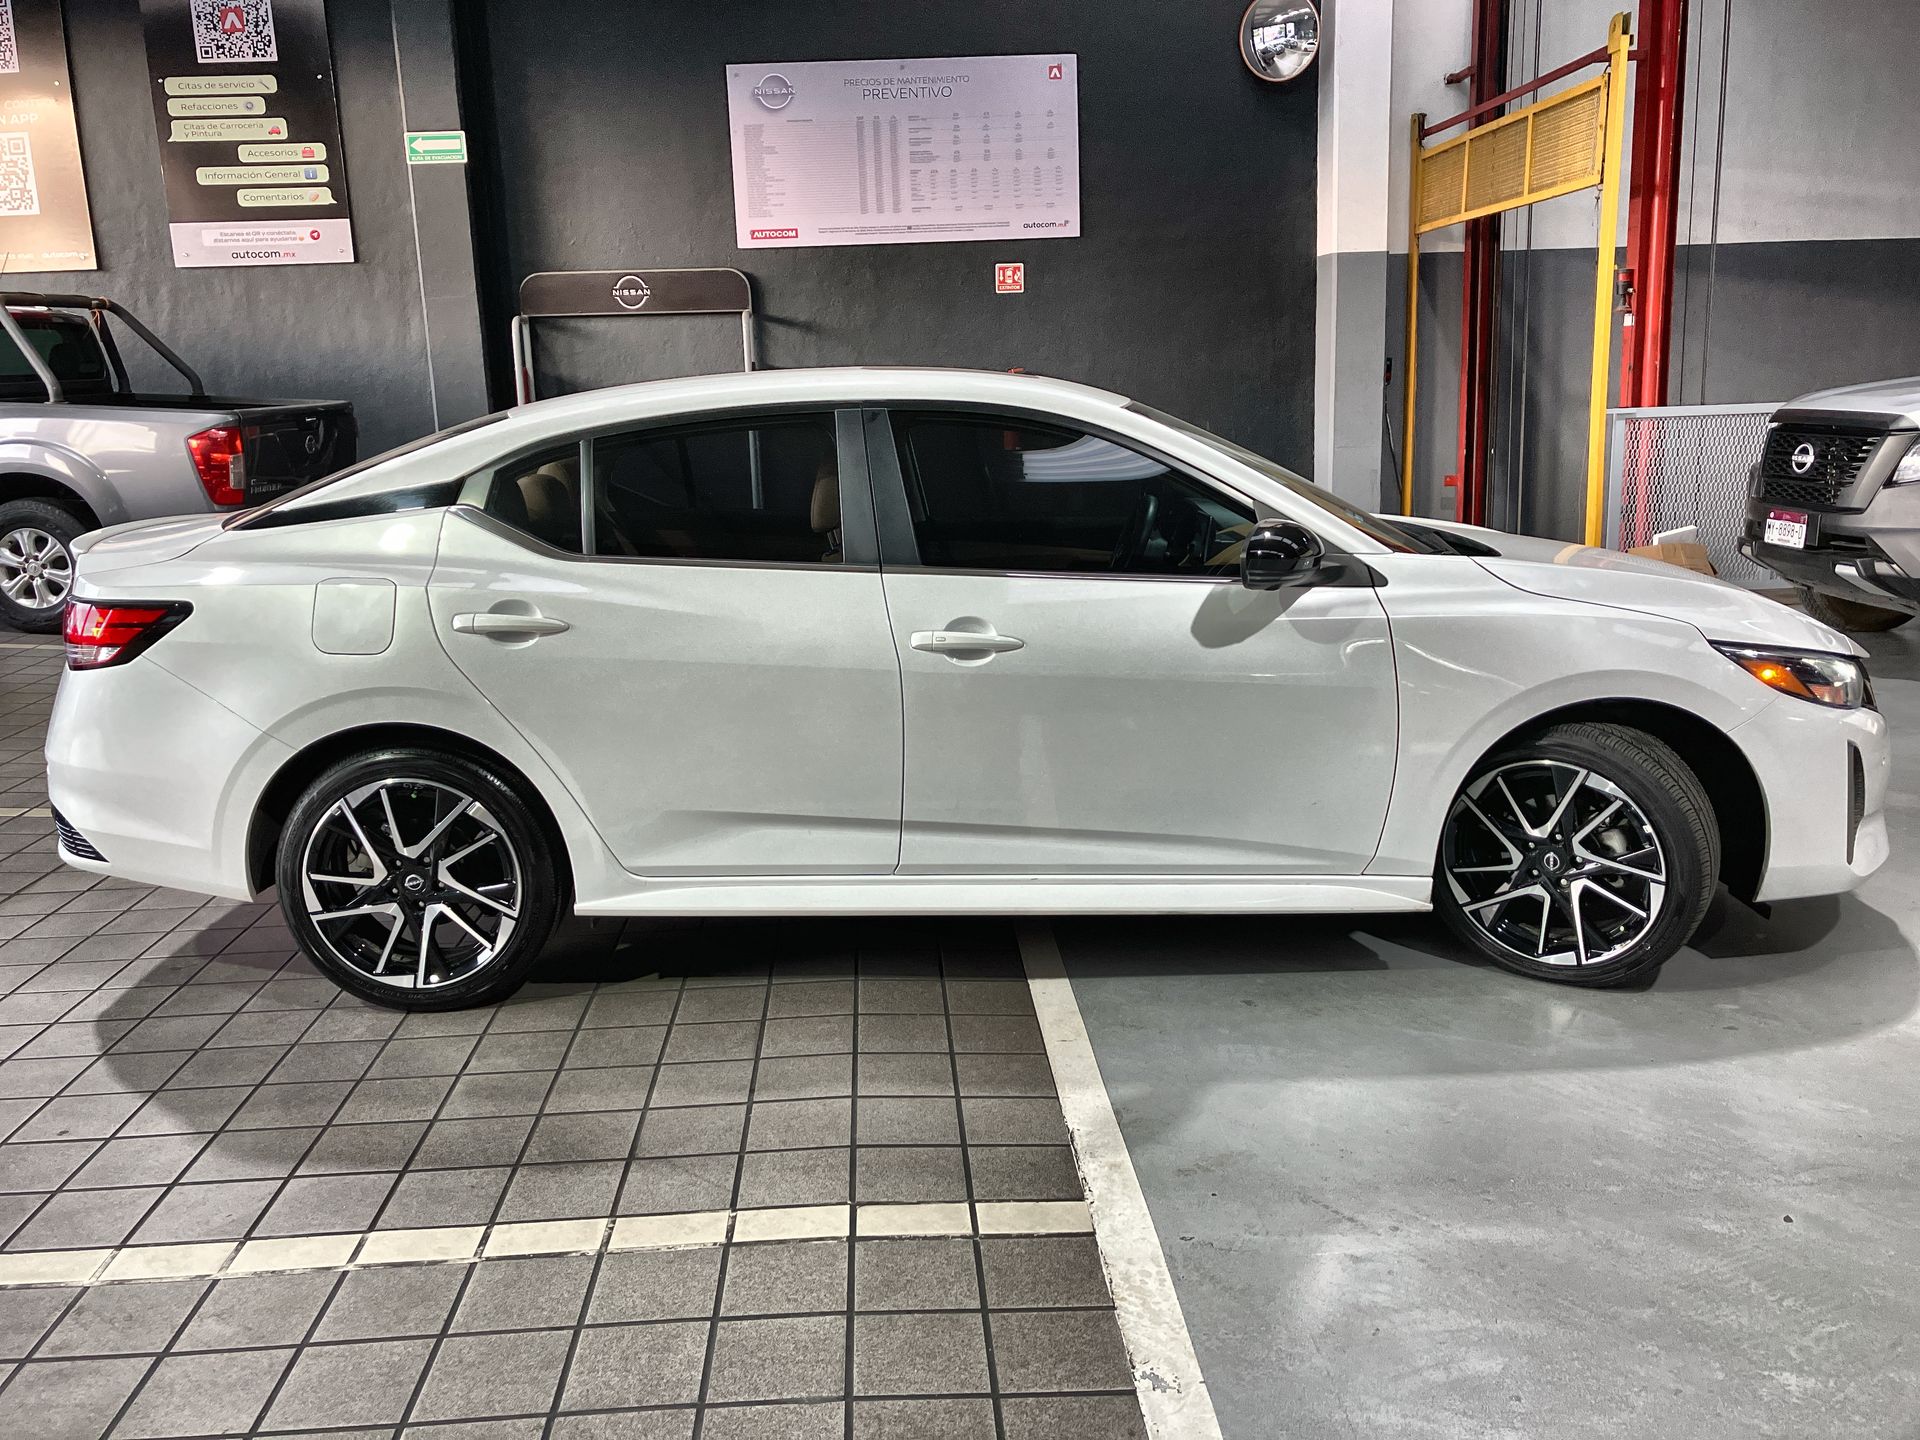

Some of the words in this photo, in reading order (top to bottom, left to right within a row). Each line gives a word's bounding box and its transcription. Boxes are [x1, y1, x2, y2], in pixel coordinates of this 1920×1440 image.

[843, 78, 881, 87] PRECIOS
[883, 77, 896, 86] DE
[897, 75, 970, 85] MANTENIMIENTO
[178, 82, 202, 90] Citas
[218, 81, 255, 89] servicio
[754, 87, 796, 96] NISSAN
[862, 86, 953, 101] PREVENTIVO
[181, 103, 239, 111] Refacciones
[184, 123, 206, 131] Citas
[191, 130, 223, 138] Pintura
[247, 149, 299, 157] Accesorios
[205, 171, 263, 180] Información
[264, 170, 301, 178] General
[243, 193, 305, 202] Comentarios
[753, 230, 797, 238] AUTOCOM
[612, 288, 651, 296] NISSAN
